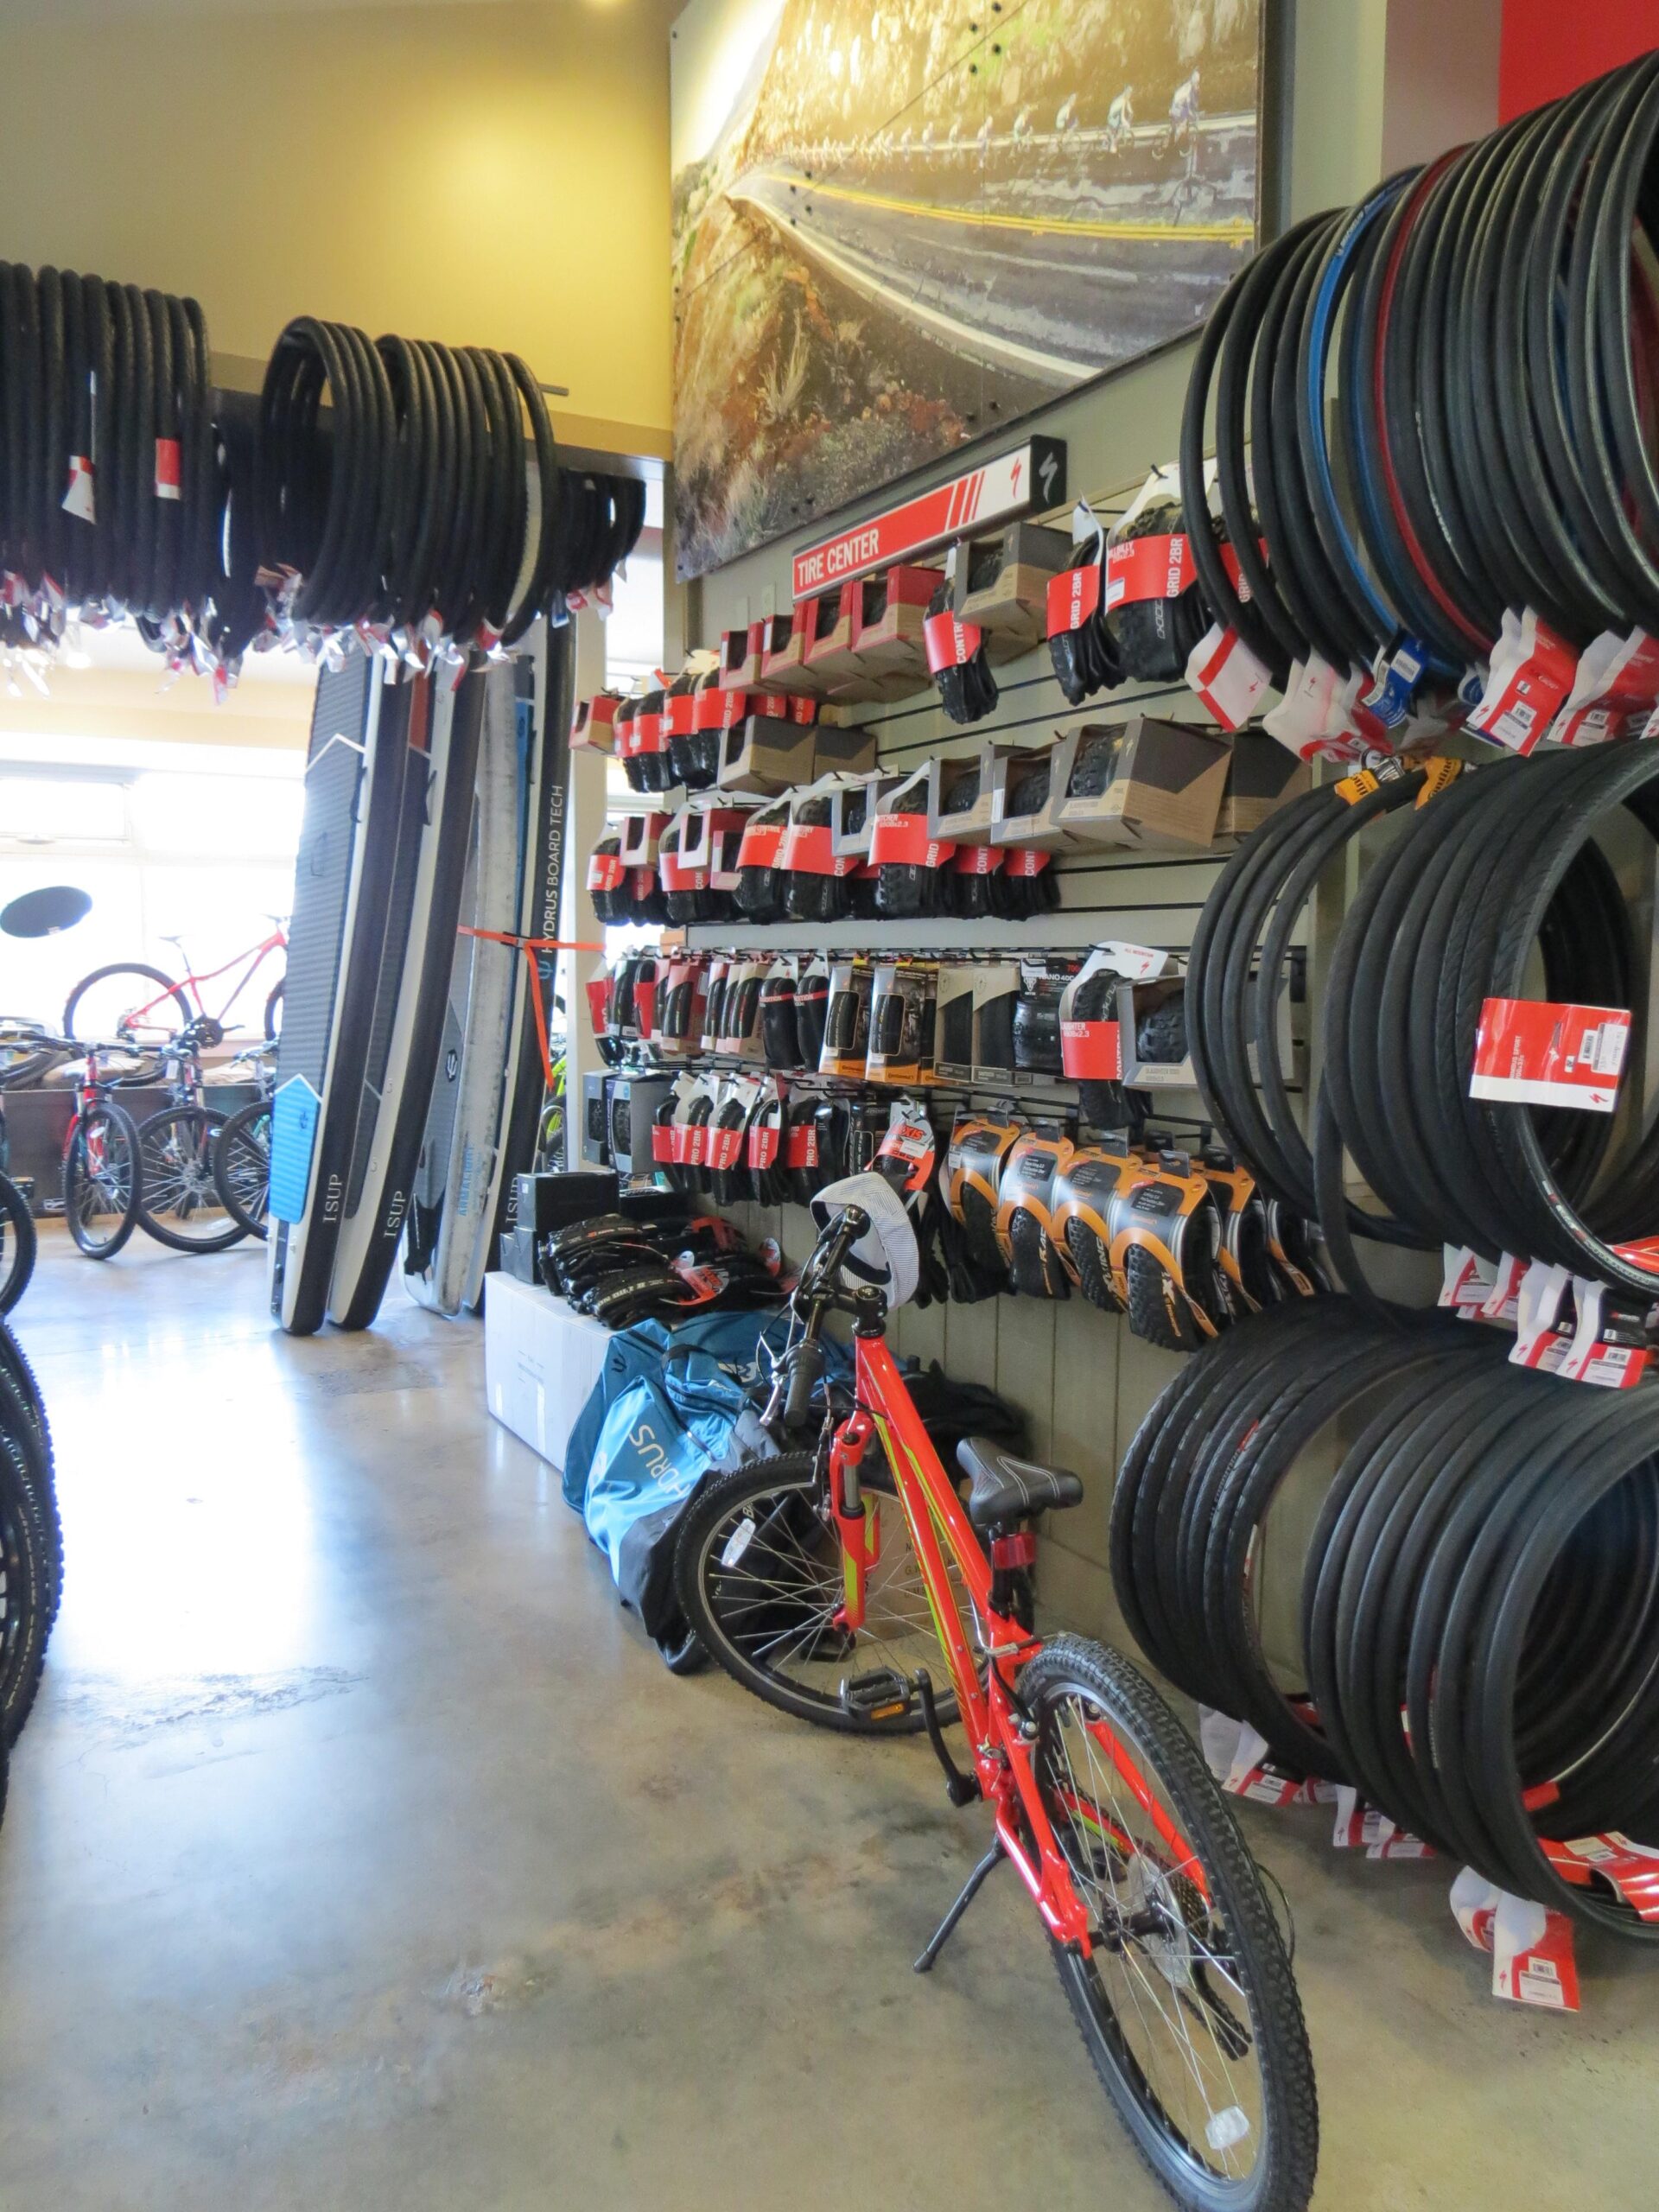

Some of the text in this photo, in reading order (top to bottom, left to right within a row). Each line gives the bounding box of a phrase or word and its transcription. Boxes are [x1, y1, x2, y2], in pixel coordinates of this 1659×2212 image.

[798, 528, 880, 588] TIRE CENTER
[1166, 537, 1183, 598] GRID 2BR
[1071, 572, 1082, 630] GRID 2BR
[953, 620, 968, 664] CONTR
[542, 785, 563, 953] HYDRUS BOARD TECH
[835, 857, 846, 877] CON
[926, 842, 939, 868] GRID
[977, 847, 988, 874] CONT
[1025, 850, 1036, 876] CONT
[691, 1129, 702, 1166] PRO 2BR
[719, 1133, 732, 1170] PRO 2BR
[759, 1131, 769, 1169] PRO 2BR
[806, 1128, 817, 1166] PRO 2BR
[322, 1173, 343, 1224] ISUP
[383, 1190, 406, 1239] ISUP
